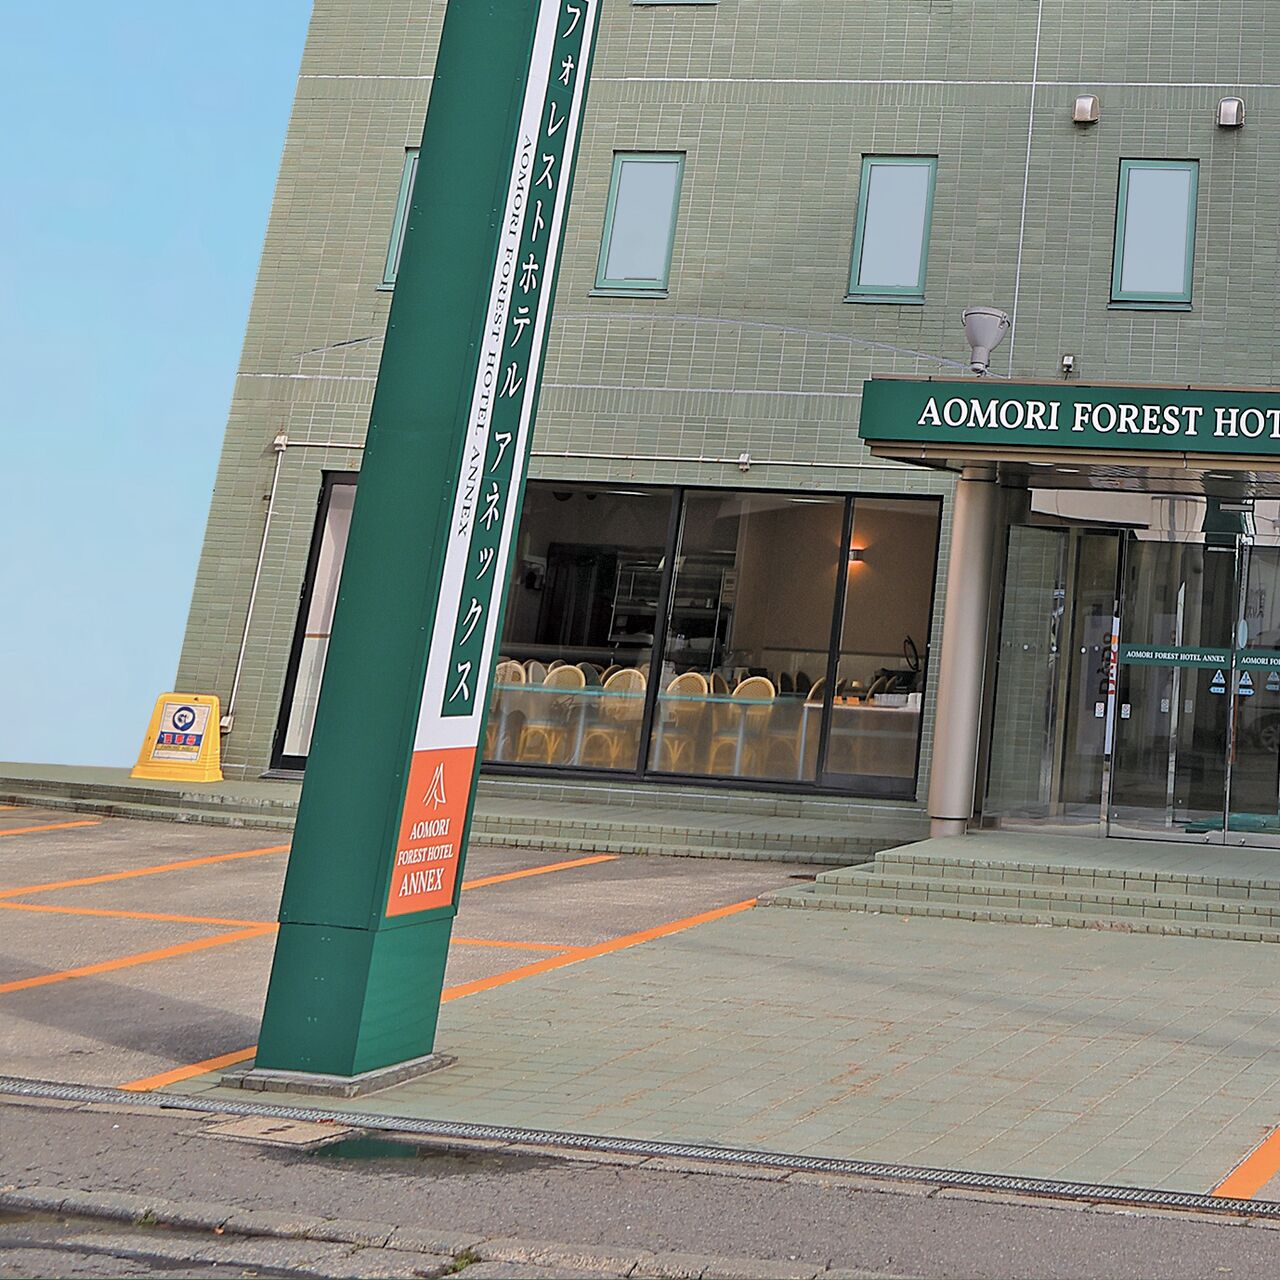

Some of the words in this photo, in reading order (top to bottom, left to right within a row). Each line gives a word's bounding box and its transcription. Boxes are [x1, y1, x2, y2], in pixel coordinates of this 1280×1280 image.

[499, 3, 582, 399] フォレストホテル
[509, 134, 532, 236] AOMORI
[491, 247, 514, 343] FOREST
[475, 352, 496, 436] HOTEL
[917, 396, 1060, 430] AOMORI
[1071, 402, 1203, 436] FOREST
[458, 446, 481, 536] ANNEX
[449, 432, 512, 702] アネックス
[1126, 650, 1153, 659] AOMORI
[1154, 652, 1179, 660] FOREST
[1180, 653, 1201, 661] HOTEL
[1203, 654, 1225, 663] ANNEX
[1241, 656, 1269, 665] AOMORI
[397, 846, 428, 866] FOREST
[427, 843, 453, 861] HOTEL
[409, 818, 450, 840] AOMORI
[399, 867, 444, 897] ANNEX
